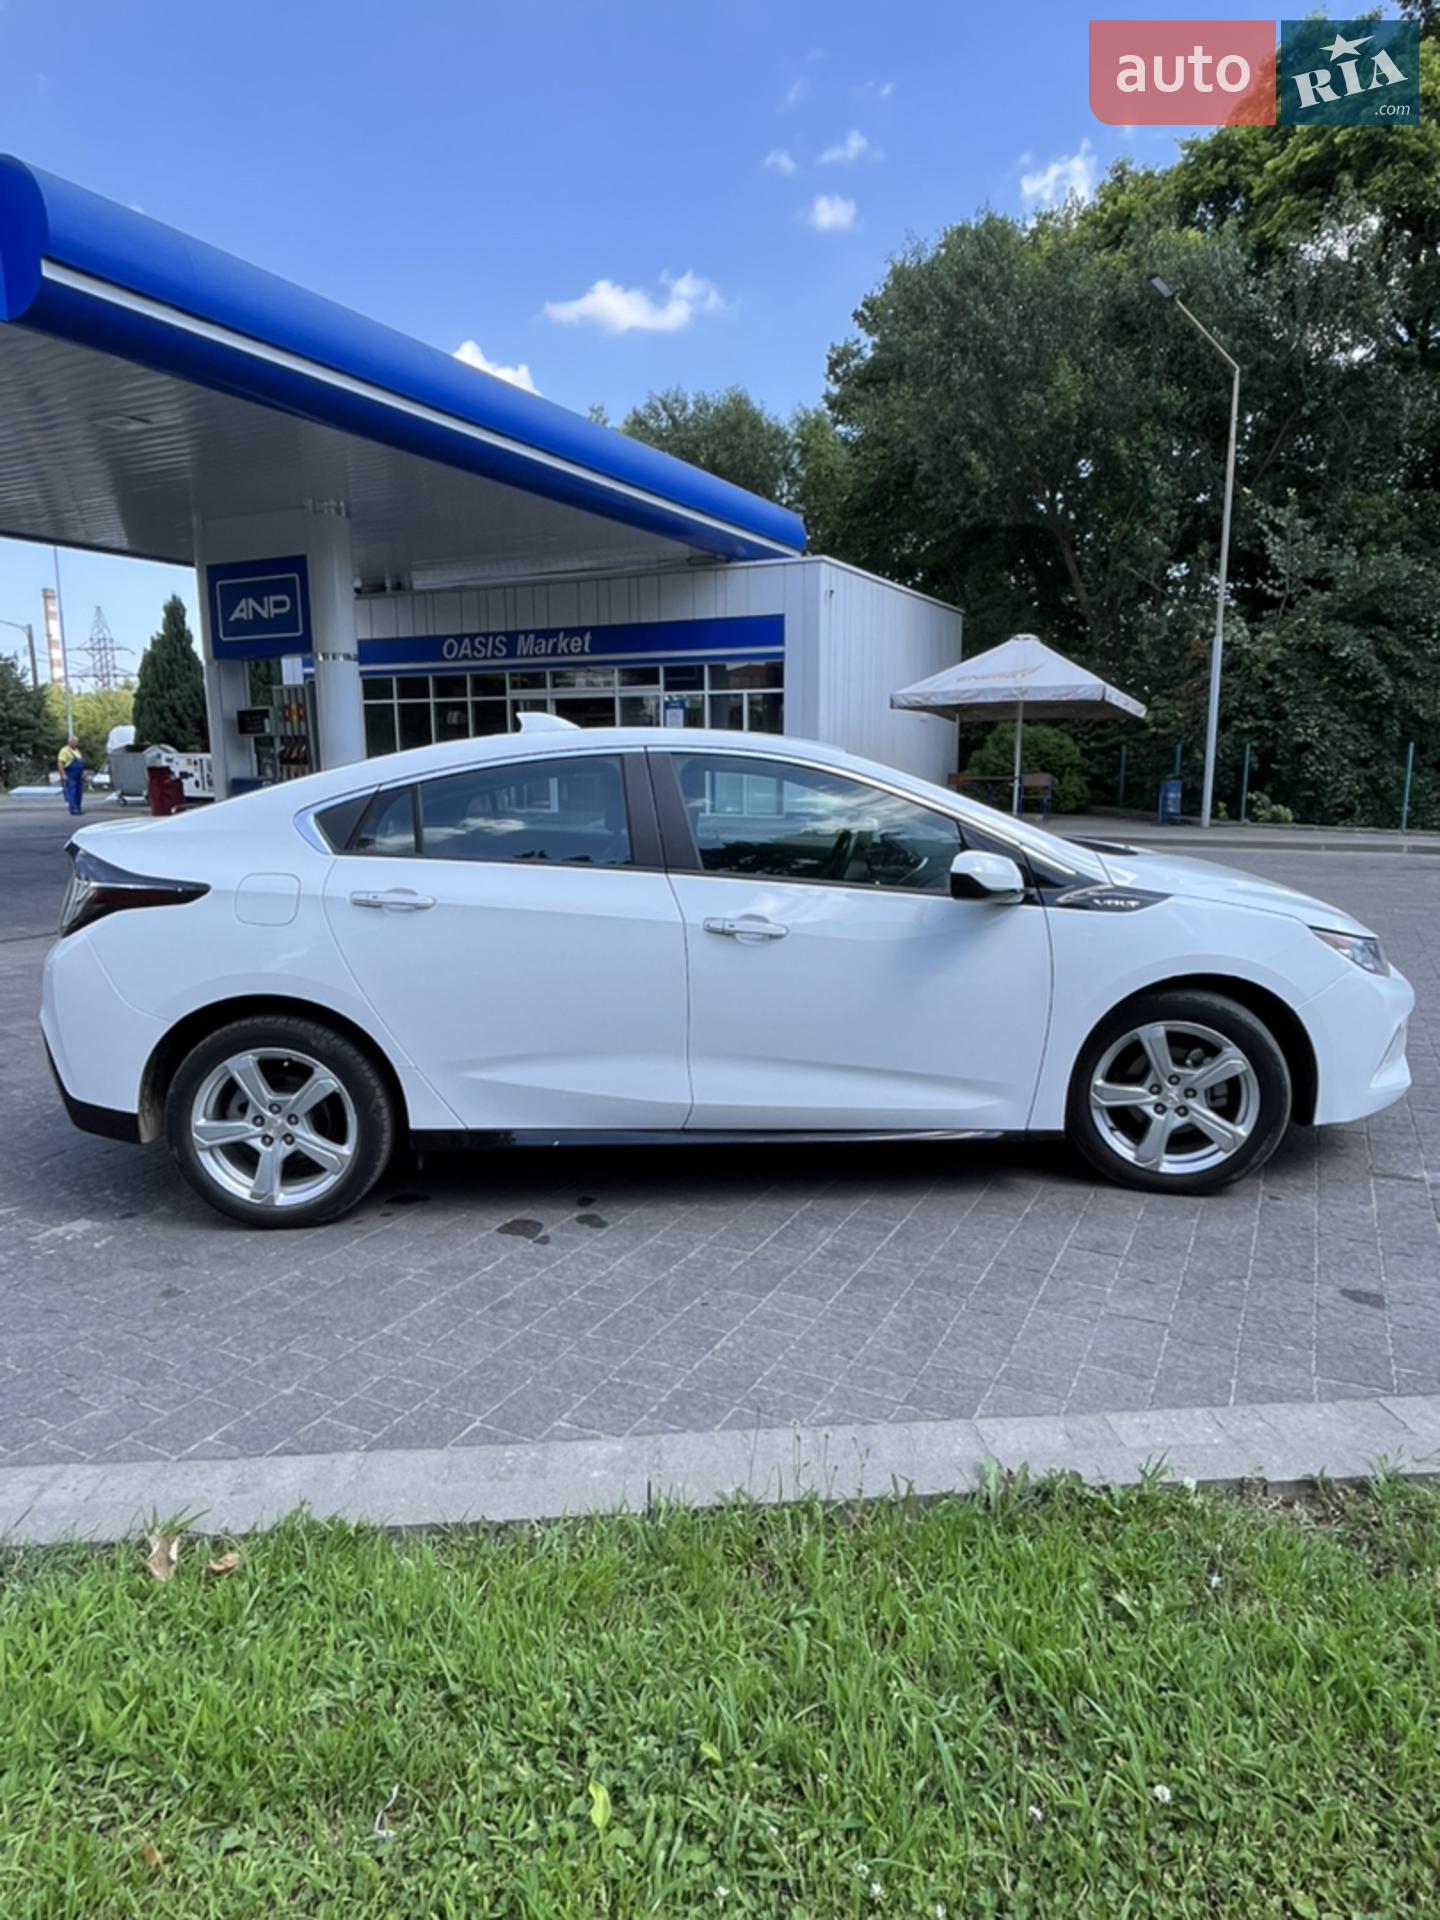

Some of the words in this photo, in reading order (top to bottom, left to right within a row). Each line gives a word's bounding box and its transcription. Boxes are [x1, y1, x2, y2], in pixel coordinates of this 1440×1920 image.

[229, 594, 291, 621] ANP
[442, 635, 508, 660] OASIS
[516, 631, 593, 657] Market
